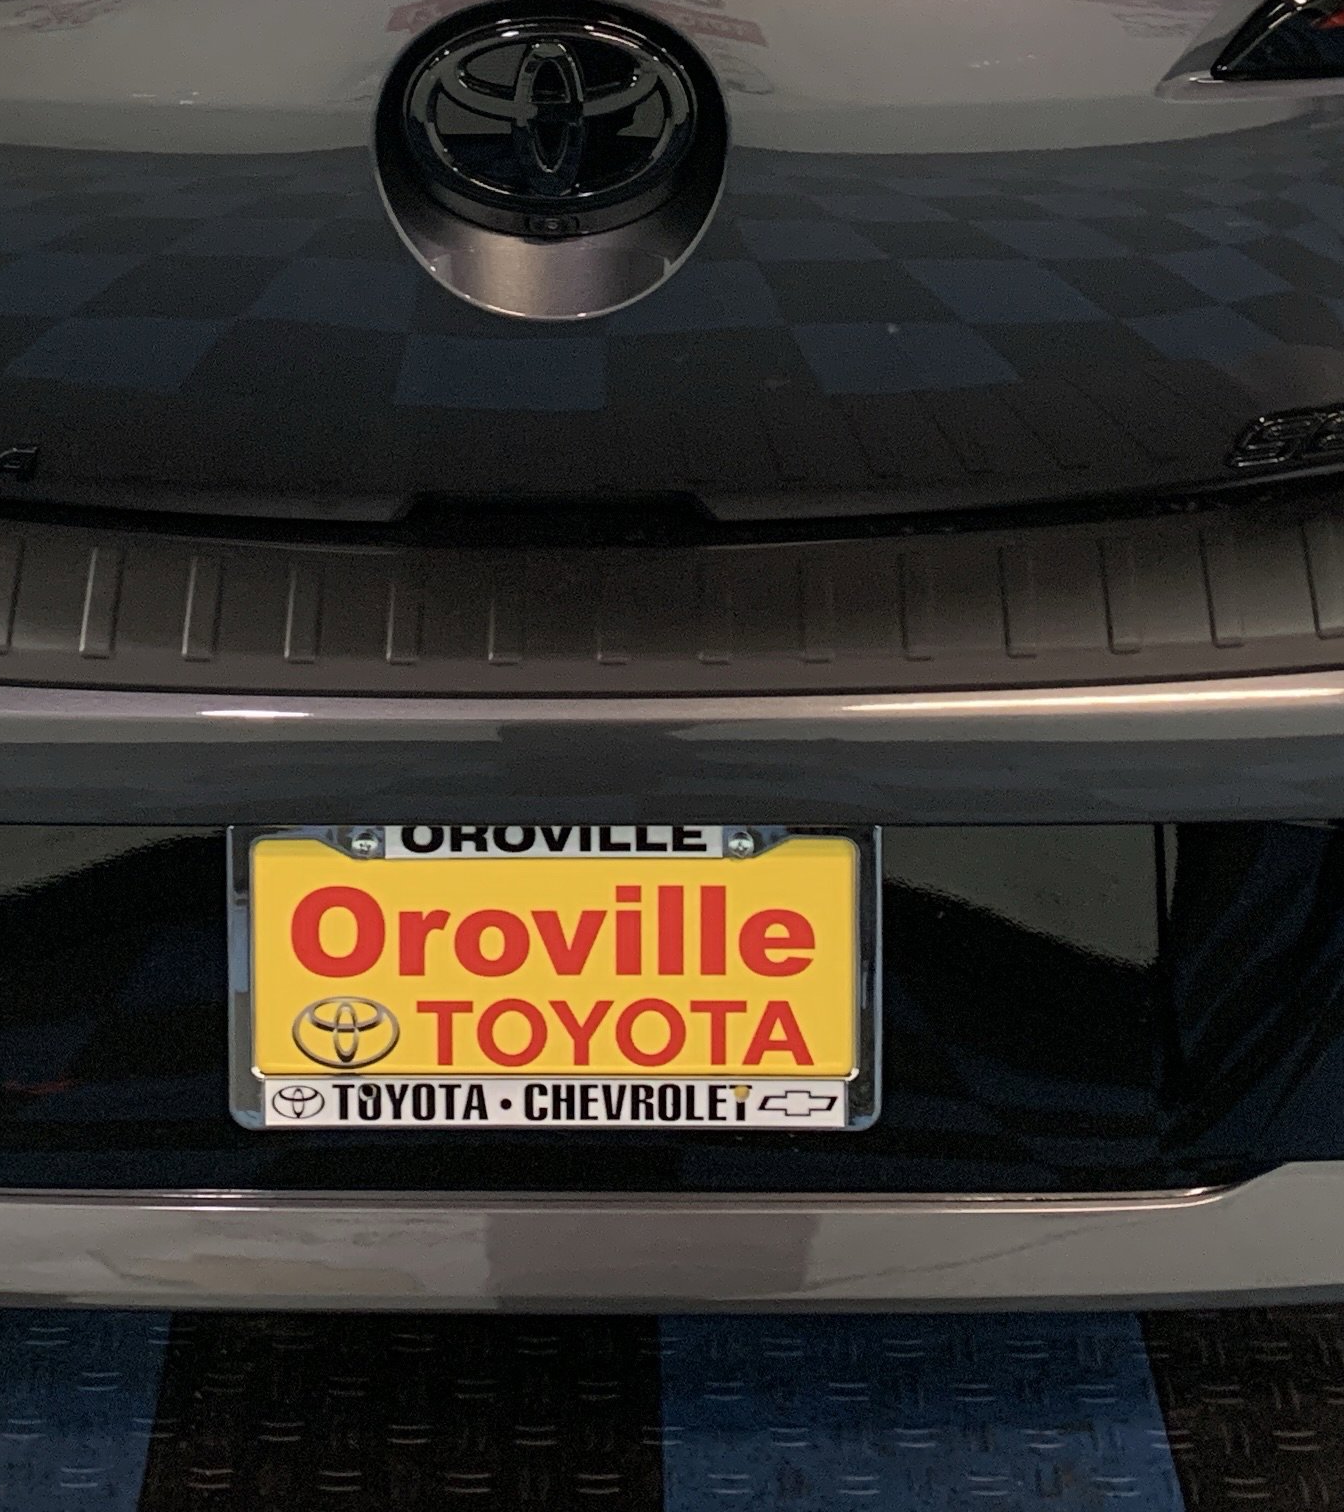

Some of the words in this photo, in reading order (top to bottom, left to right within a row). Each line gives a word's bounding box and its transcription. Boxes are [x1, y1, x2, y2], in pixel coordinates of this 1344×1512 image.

[401, 825, 708, 853] OROVILLE
[291, 885, 816, 978] Oroville
[416, 998, 815, 1067] TOYOTA
[339, 1083, 488, 1121] TOYOTA
[524, 1083, 752, 1122] CHEVROLET
